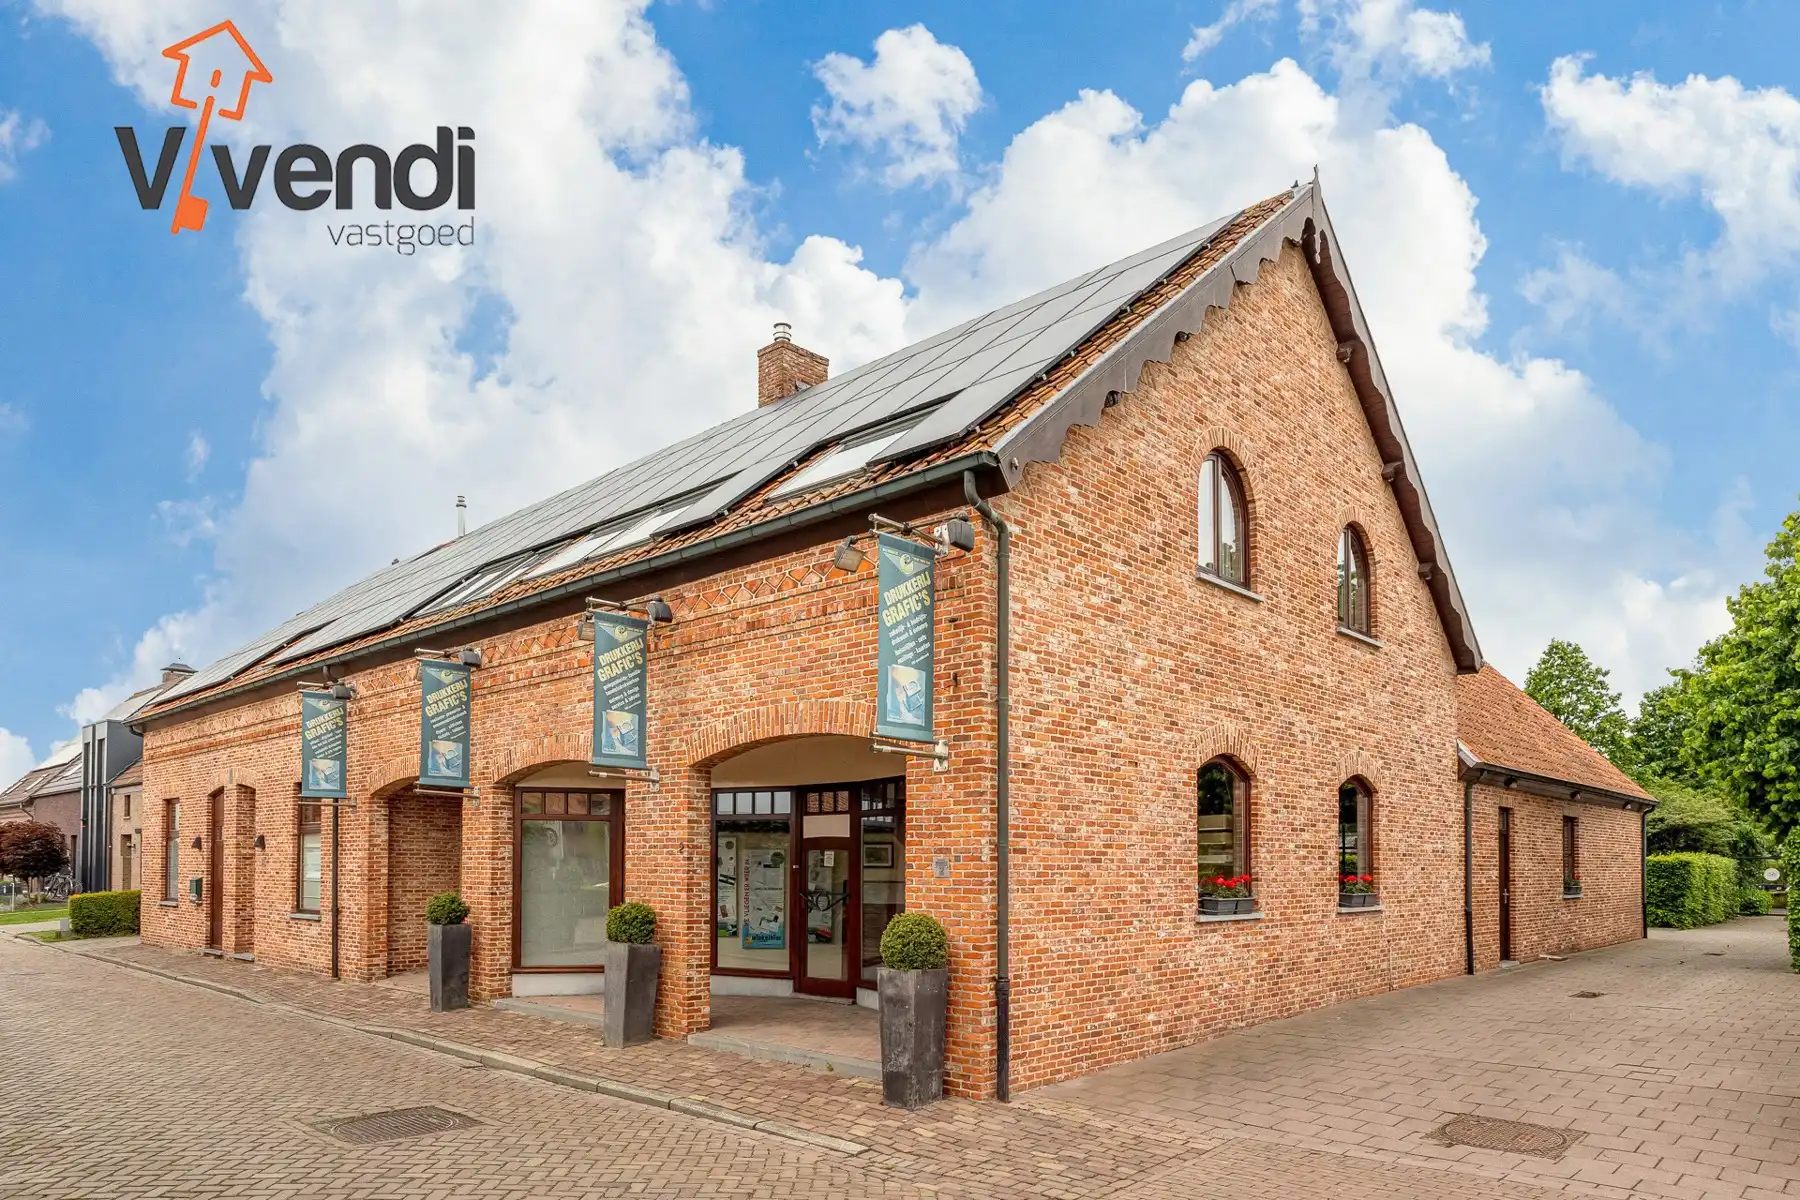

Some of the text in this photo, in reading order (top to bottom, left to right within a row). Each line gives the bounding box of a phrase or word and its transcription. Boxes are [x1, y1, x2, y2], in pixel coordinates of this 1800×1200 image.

[884, 571, 931, 606] DRUKKERIJ
[882, 589, 931, 627] GRAFIC'S
[598, 637, 644, 666] DRUKKERIJ
[597, 652, 643, 682] GRAFIC'S
[425, 691, 468, 717] GRAFIC'S
[426, 678, 468, 704] DRUKKERIJ
[304, 716, 344, 740] GRAFIC'S
[305, 707, 344, 729] DRUKKERIJ
